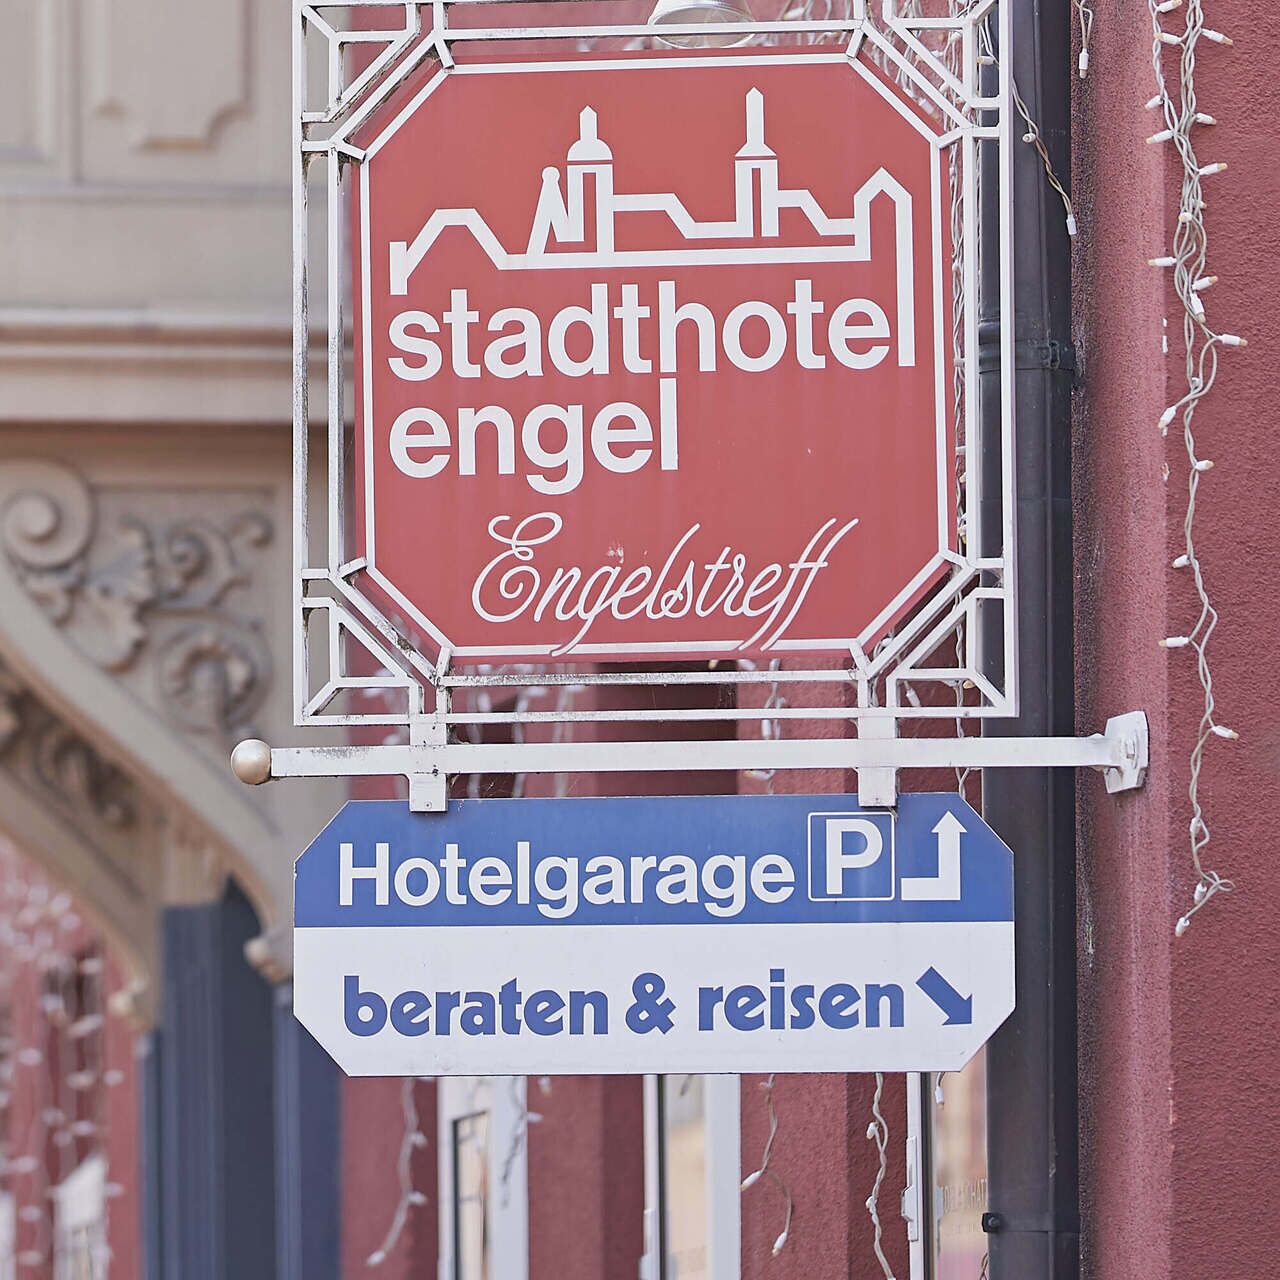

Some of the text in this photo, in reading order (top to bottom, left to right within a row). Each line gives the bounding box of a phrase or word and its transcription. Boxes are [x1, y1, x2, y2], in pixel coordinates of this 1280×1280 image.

[388, 278, 916, 382] stadthotel
[388, 377, 679, 495] engel
[471, 511, 859, 657] Engelstreff
[338, 817, 885, 920] Hotelgarage P
[343, 968, 905, 1037] beraten & reisen
